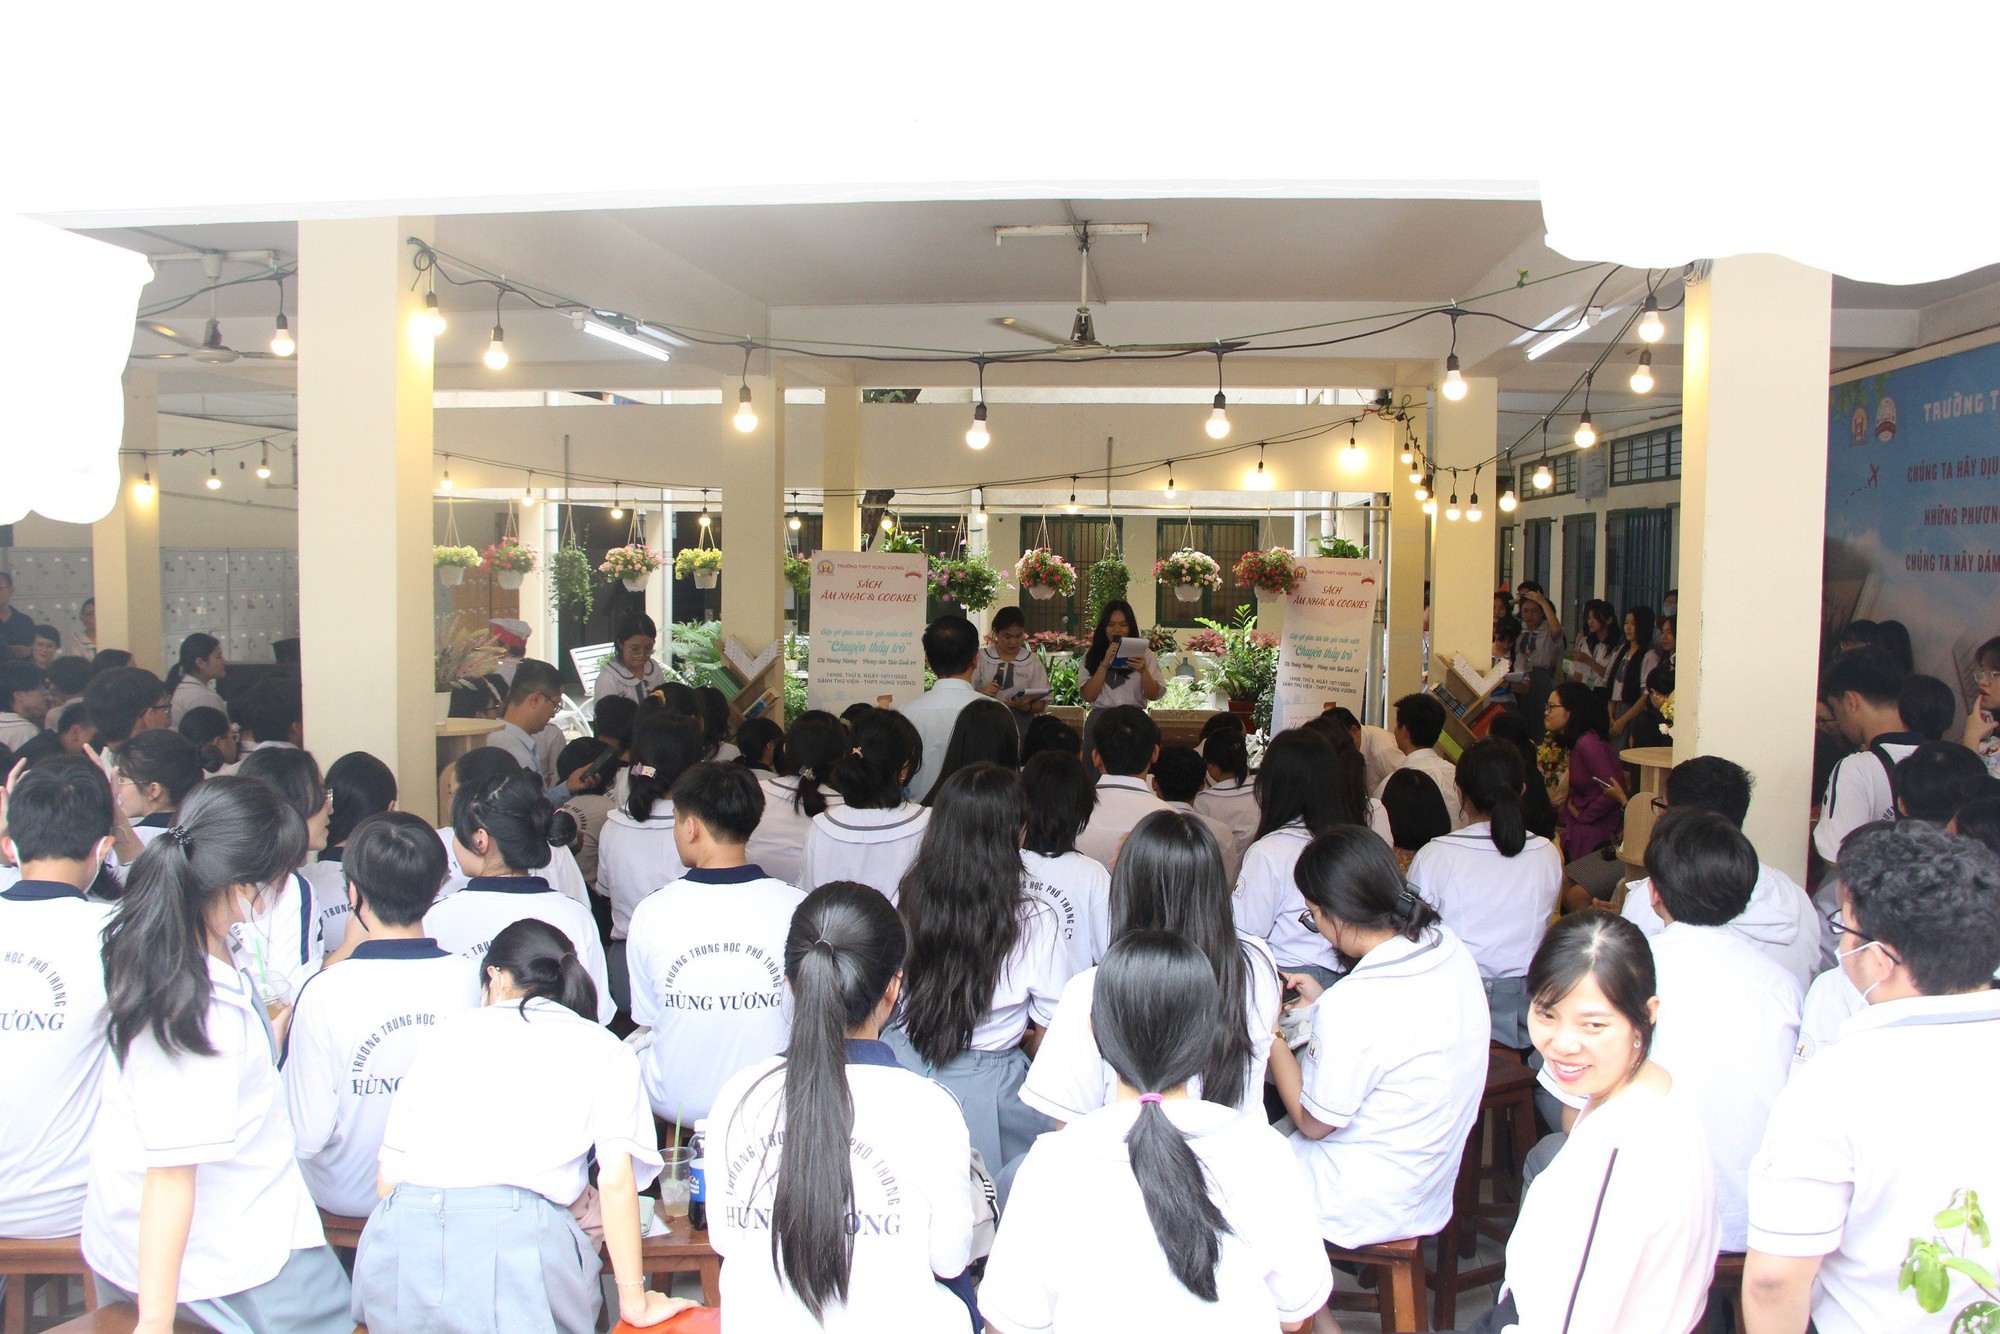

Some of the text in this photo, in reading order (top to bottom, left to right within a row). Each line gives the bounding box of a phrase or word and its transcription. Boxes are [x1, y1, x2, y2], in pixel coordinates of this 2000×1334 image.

[1923, 391, 1984, 422] TRƯỜNG
[1907, 460, 1938, 483] CHÚNG
[1941, 461, 1953, 480] TA
[1957, 455, 1977, 479] HÃY
[1924, 504, 2000, 527] NHỮNG PHƯƠN
[1905, 549, 1936, 572] CHÚNG
[1939, 554, 1951, 572] TA
[1954, 550, 1974, 573] HÃY
[856, 578, 883, 590] SÁCH
[1321, 584, 1343, 595] SÁCH
[838, 592, 866, 602] NHẠC
[867, 593, 875, 601] &
[878, 593, 918, 602] COOKIES
[1336, 599, 1368, 609] COOKIES
[471, 940, 491, 956] TRU
[689, 943, 720, 960] TRUNG
[664, 989, 782, 1012] HÙNG VƯƠNG
[0, 1009, 65, 1031] ƯƠNG
[381, 1014, 412, 1036] TRUNG
[726, 1200, 772, 1231] HÙN
